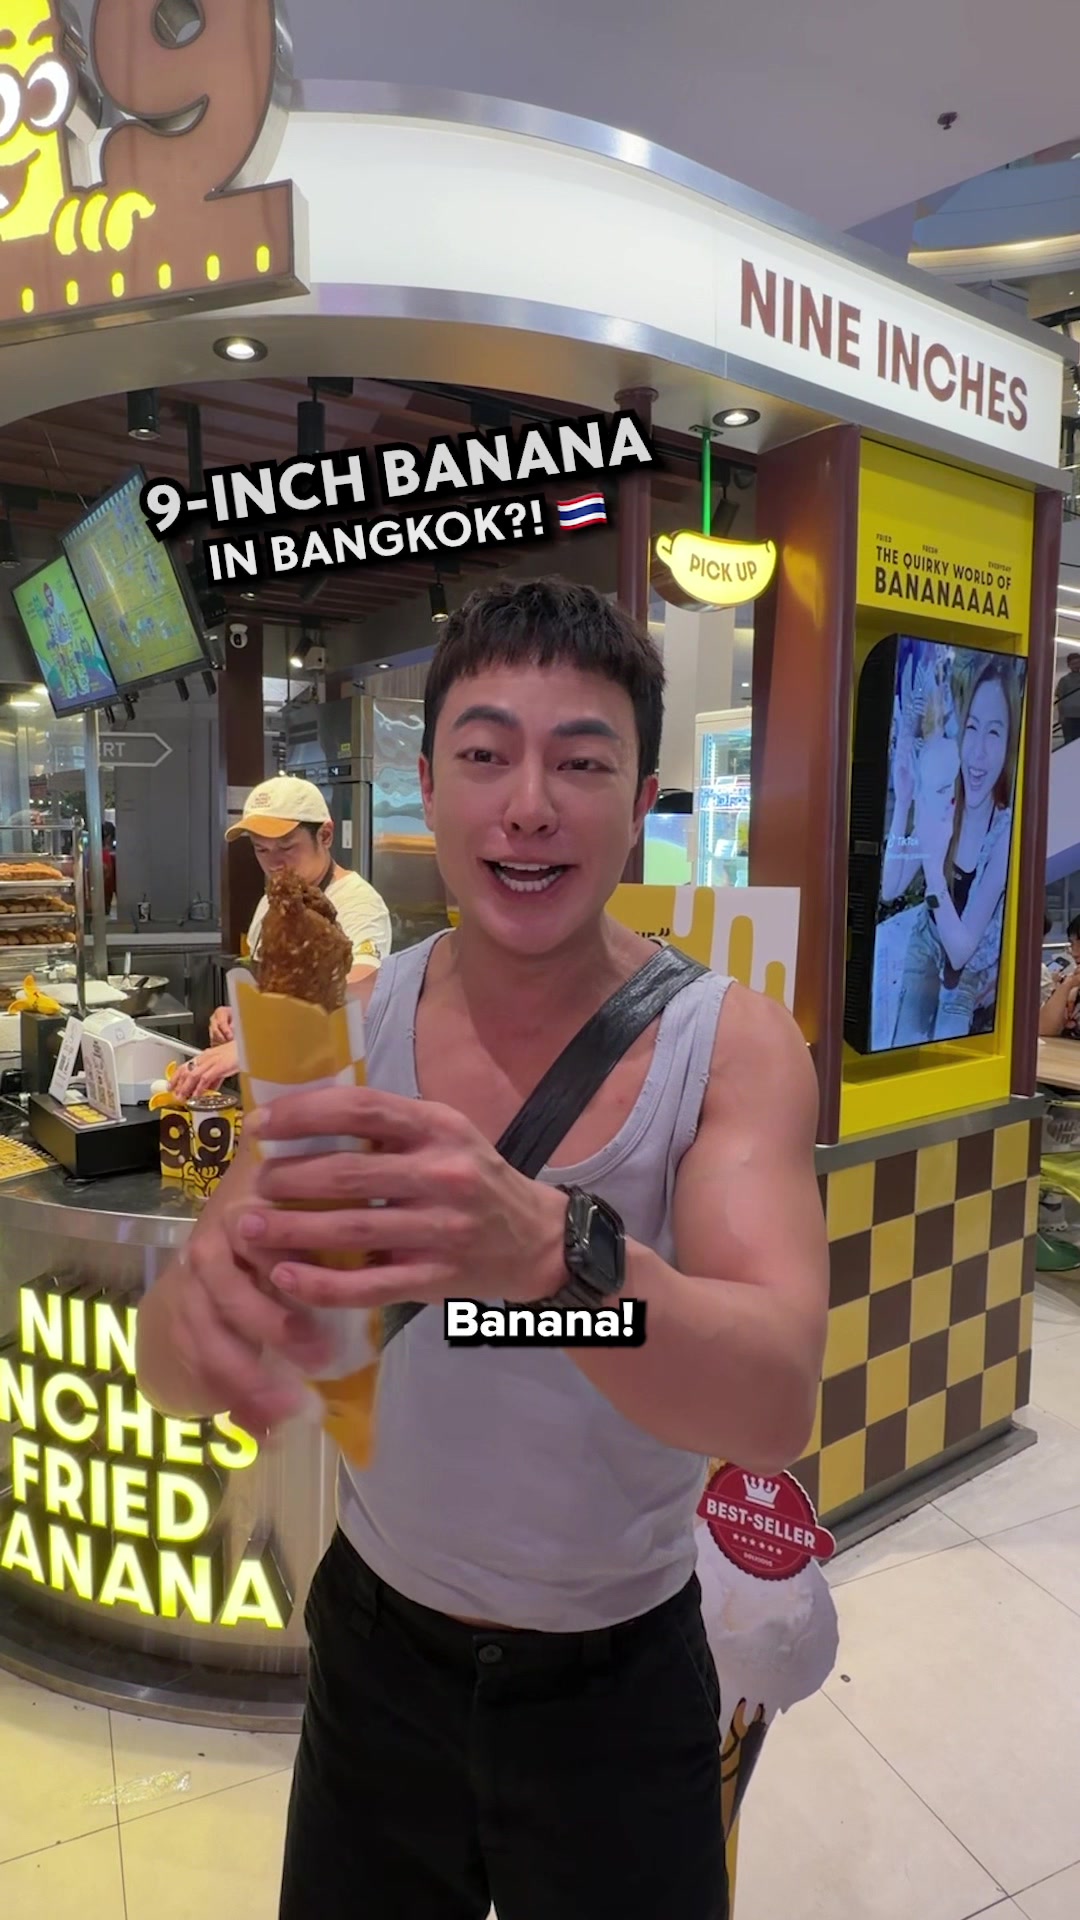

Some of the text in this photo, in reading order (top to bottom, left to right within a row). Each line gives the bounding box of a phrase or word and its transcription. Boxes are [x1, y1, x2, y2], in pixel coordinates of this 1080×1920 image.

[741, 258, 1028, 431] NINE INCHES
[689, 553, 757, 582] PICK UP
[874, 566, 1010, 619] BANANAAAA
[876, 546, 1012, 590] THE QUIRKY WORLD OF
[198, 1117, 231, 1162] 9
[20, 1287, 138, 1375] NIN
[0, 1357, 259, 1469] NCHES
[12, 1436, 210, 1542] FRIED
[706, 1498, 816, 1549] BEST-SELLER
[0, 1510, 285, 1630] ANANA
